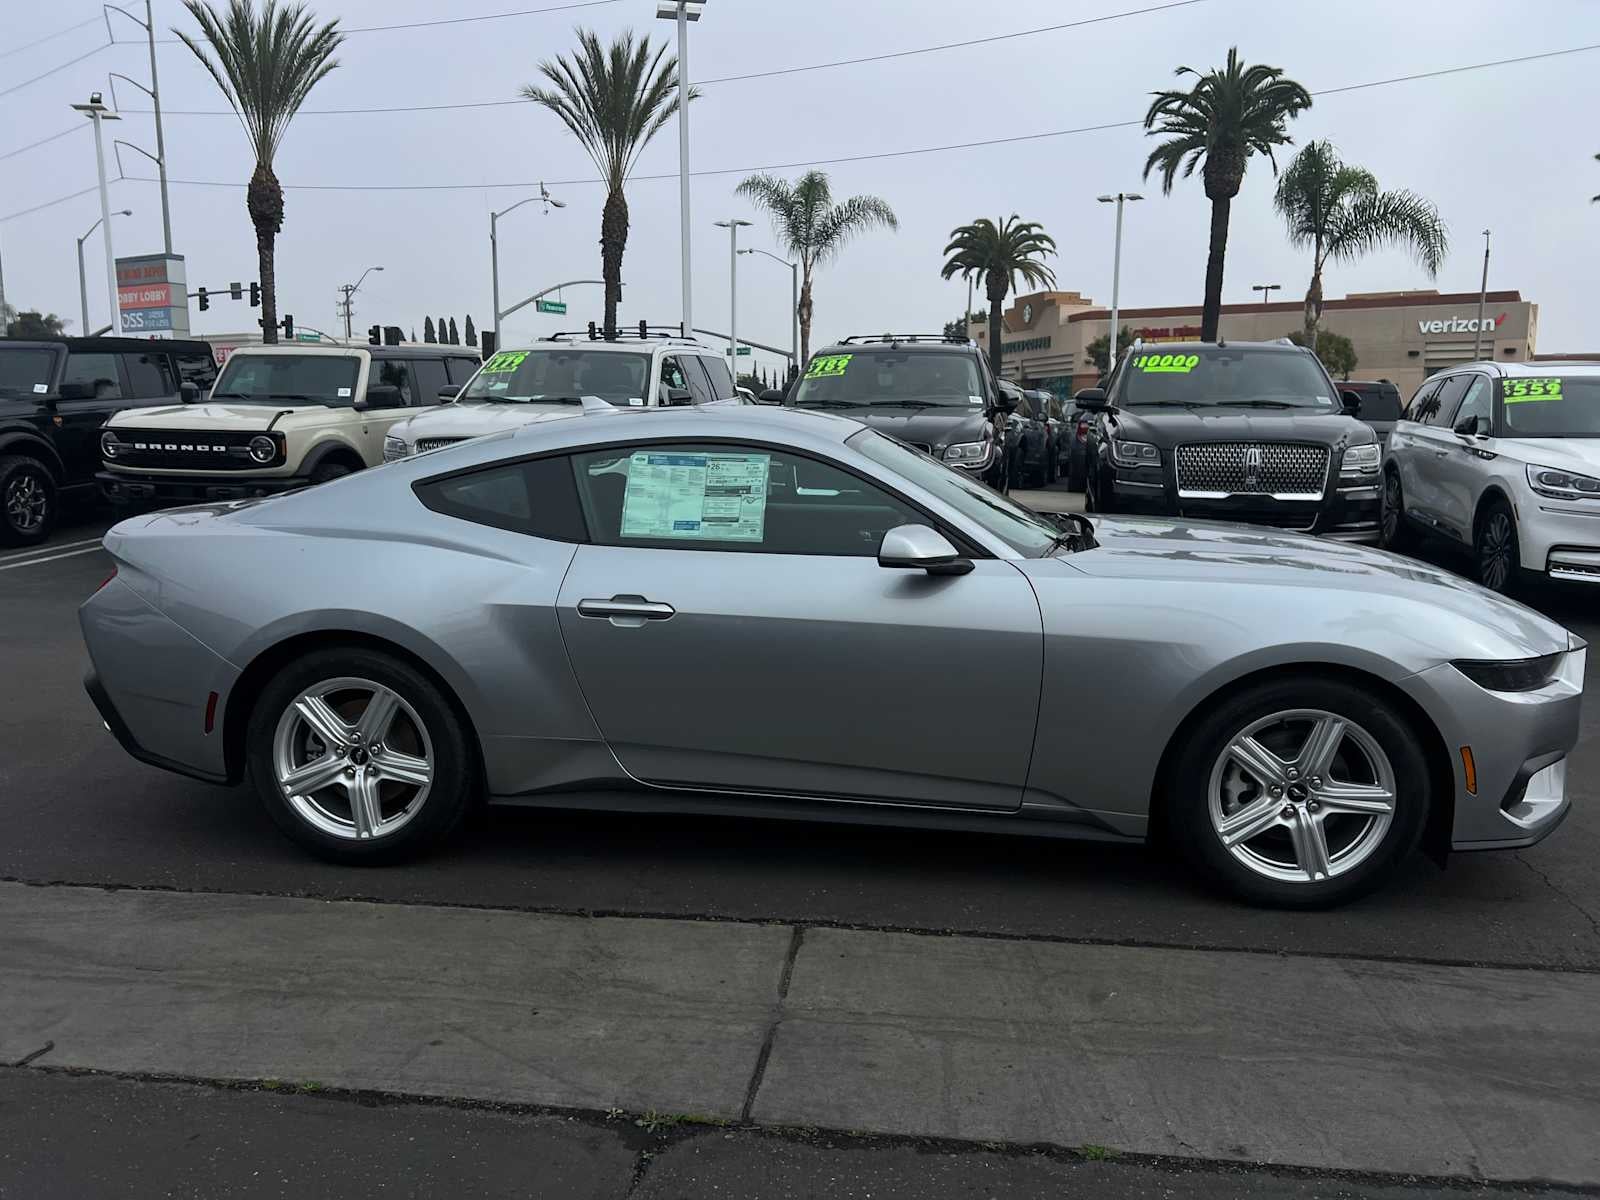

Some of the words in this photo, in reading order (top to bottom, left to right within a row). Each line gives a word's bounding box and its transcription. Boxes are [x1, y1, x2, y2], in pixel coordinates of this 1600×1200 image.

[118, 292, 138, 304] OBBY
[140, 289, 167, 302] LOBBY
[121, 312, 144, 328] OSS
[1418, 316, 1495, 334] verizon
[1132, 354, 1200, 368] $10000
[1503, 383, 1562, 397] $559
[134, 443, 226, 451] BRONCO
